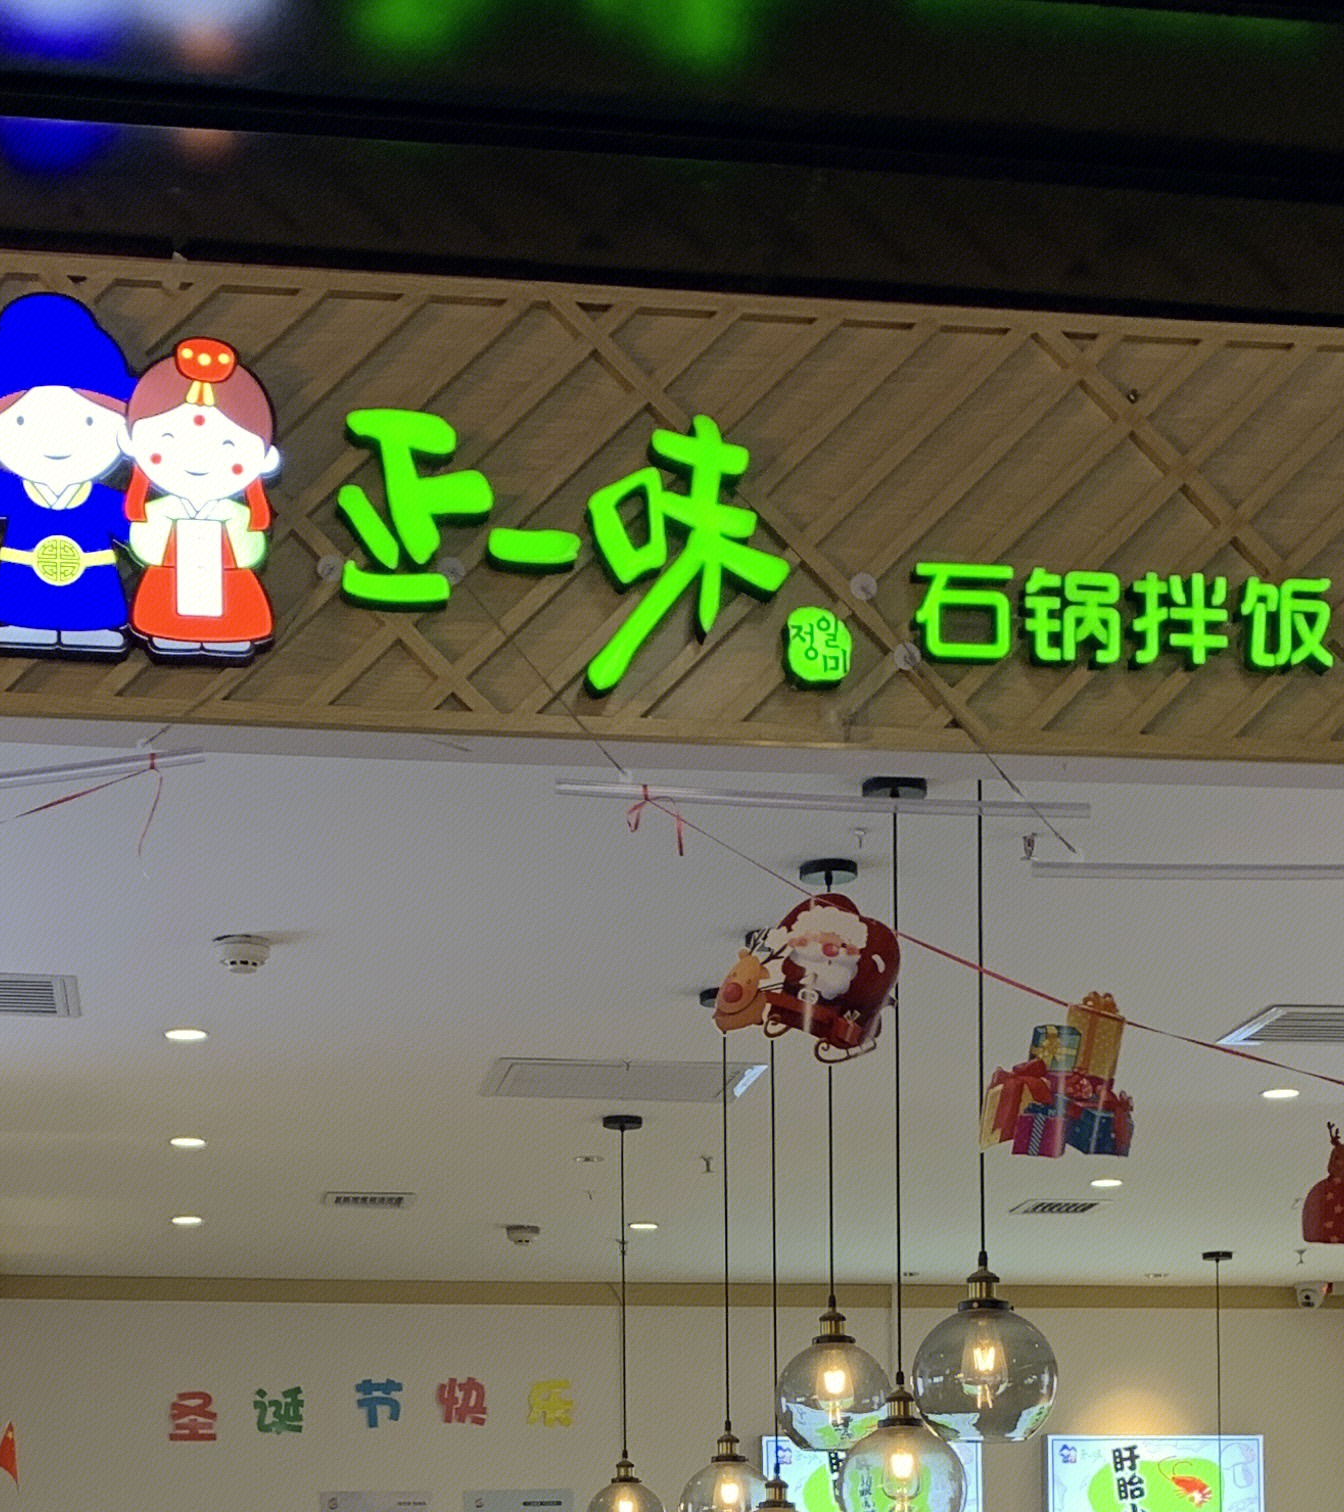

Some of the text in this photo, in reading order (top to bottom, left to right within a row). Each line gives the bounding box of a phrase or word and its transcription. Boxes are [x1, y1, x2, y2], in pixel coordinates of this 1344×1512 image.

[337, 407, 791, 692] 正一味
[790, 612, 850, 675] 정일미
[914, 561, 1335, 668] 石锅拌饭
[168, 1376, 575, 1442] 圣诞节快乐
